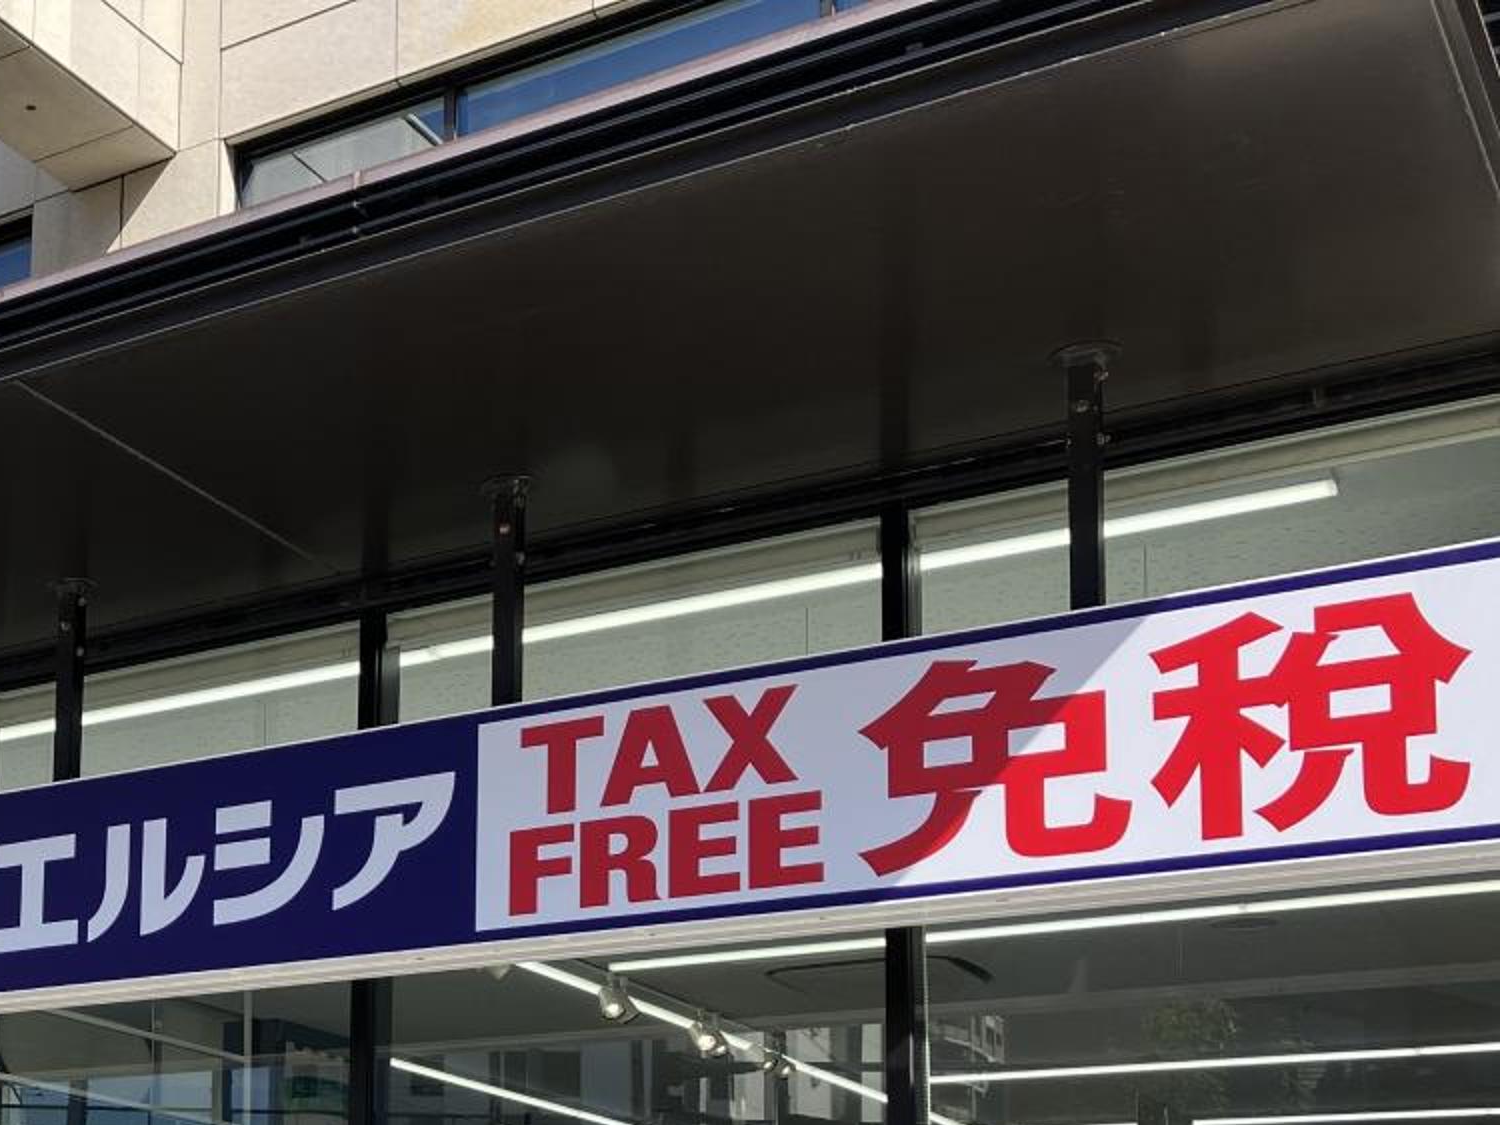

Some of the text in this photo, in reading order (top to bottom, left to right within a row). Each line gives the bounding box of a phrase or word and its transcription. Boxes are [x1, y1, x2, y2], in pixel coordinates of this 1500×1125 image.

[521, 684, 797, 814] TAX
[860, 592, 1472, 877] 免税
[507, 791, 823, 917] FREE
